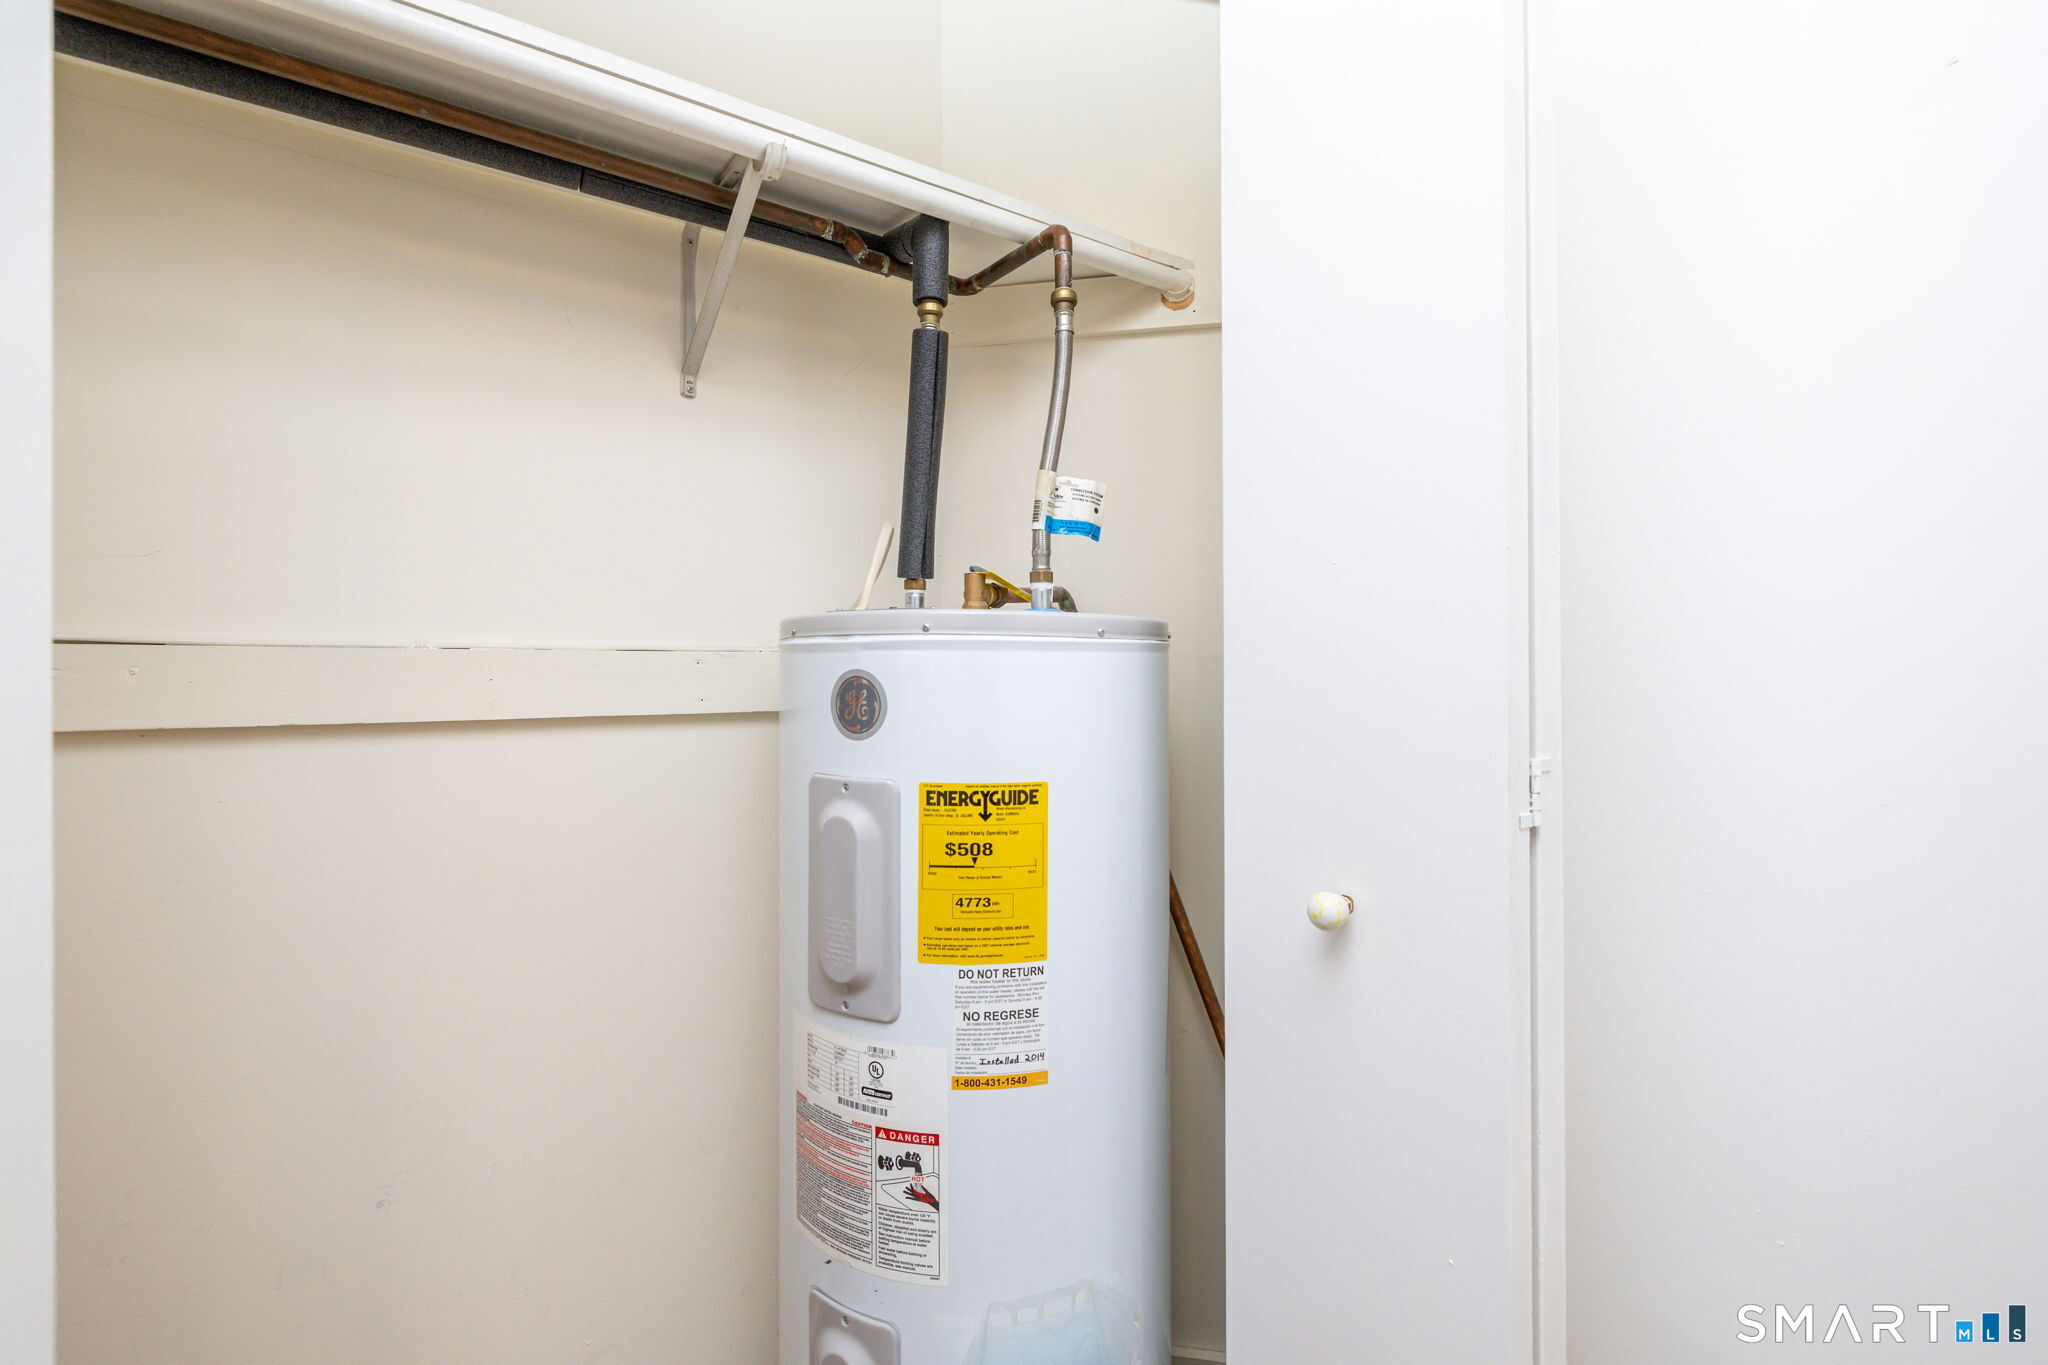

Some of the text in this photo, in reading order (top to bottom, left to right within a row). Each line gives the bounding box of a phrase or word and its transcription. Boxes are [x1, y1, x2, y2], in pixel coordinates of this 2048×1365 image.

[926, 789, 1039, 807] ENERGYGUIDE
[944, 841, 993, 858] $508
[955, 897, 991, 908] 4773
[958, 965, 1044, 979] DO NOT RETURN
[963, 1008, 1040, 1021] NO REGRESE
[980, 1054, 1020, 1065] Installed
[1025, 1052, 1045, 1062] 2014
[872, 1065, 880, 1075] UL
[955, 1076, 1028, 1088] 1-800-431-1549
[851, 1120, 872, 1129] CAUTION
[889, 1133, 935, 1144] DANGER
